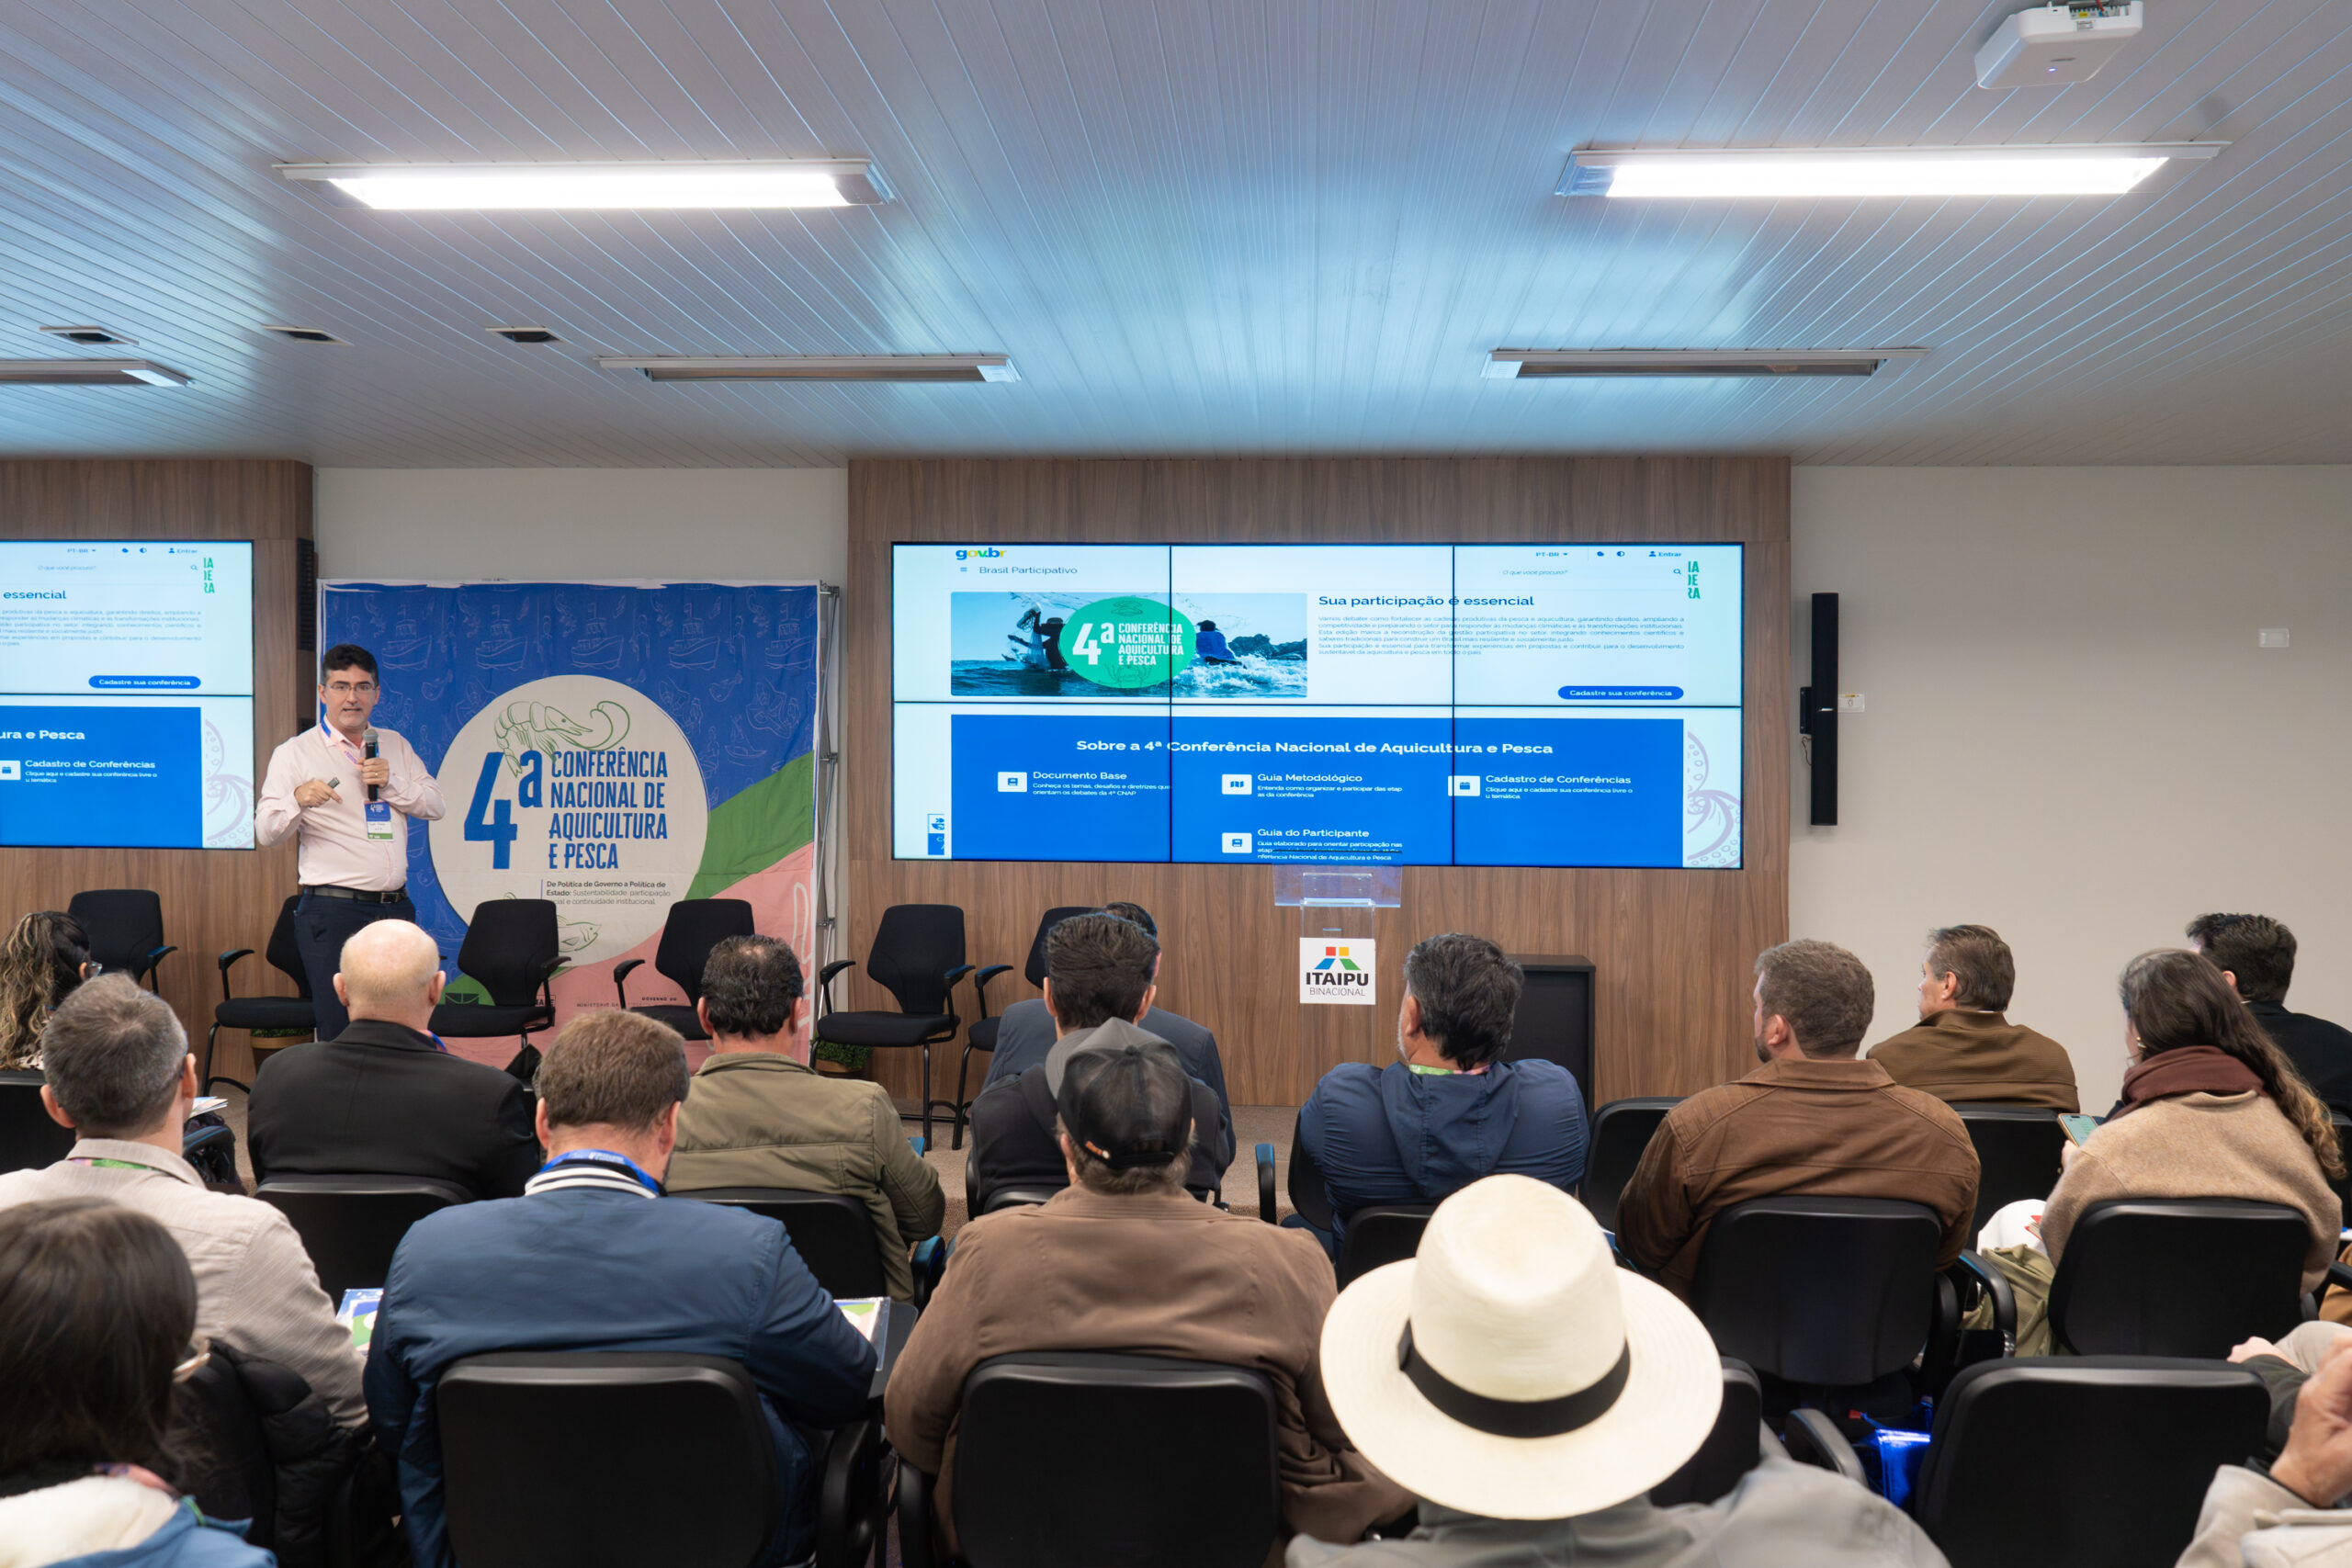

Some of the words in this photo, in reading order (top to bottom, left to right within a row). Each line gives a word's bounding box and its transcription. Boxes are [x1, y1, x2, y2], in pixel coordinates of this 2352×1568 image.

[956, 547, 1007, 560] gov.br
[979, 566, 1009, 574] Brasil
[1012, 566, 1078, 575] Participativo
[3, 590, 66, 600] essencial
[1318, 596, 1347, 606] Sua
[1351, 596, 1444, 608] participação
[1448, 595, 1459, 606] é
[1464, 596, 1534, 606] essencial
[1118, 622, 1183, 634] CONFERÊNCIA
[1072, 623, 1114, 665] 4ª
[1118, 634, 1166, 644] NACIONAL
[1118, 645, 1183, 655] AQUICULTURA
[1118, 655, 1125, 665] E
[1126, 655, 1156, 665] PESCA
[39, 730, 85, 740] Pesca
[1076, 740, 1126, 750] Sobre
[1130, 742, 1140, 750] a
[1145, 740, 1162, 751] 4ª
[1167, 740, 1272, 751] Conferência
[1275, 742, 1351, 752] Nacional
[1354, 742, 1376, 752] de
[1380, 742, 1483, 755] Aquicultura
[1487, 745, 1498, 753] e
[1502, 744, 1553, 753] Pesca
[25, 760, 71, 768] Cadastro
[88, 761, 156, 769] Conferências
[551, 747, 668, 778] CONFERÊNCIA
[1033, 772, 1097, 780] Documento
[1101, 772, 1127, 780] Base
[1258, 773, 1283, 782] Guia
[1285, 773, 1363, 783] Metodológico
[1556, 775, 1632, 784] Conferências
[551, 782, 638, 808] NACIONAL
[644, 783, 665, 808] DE
[464, 750, 543, 869] 4ª
[549, 813, 668, 841] AQUICULTURA
[1258, 829, 1283, 837] Guia
[1303, 829, 1369, 838] Participante
[548, 843, 558, 869] E
[564, 843, 619, 869] PESCA
[630, 890, 671, 898] participação
[1306, 972, 1369, 987] ITAIPU
[1310, 987, 1365, 997] BINACIONAL
